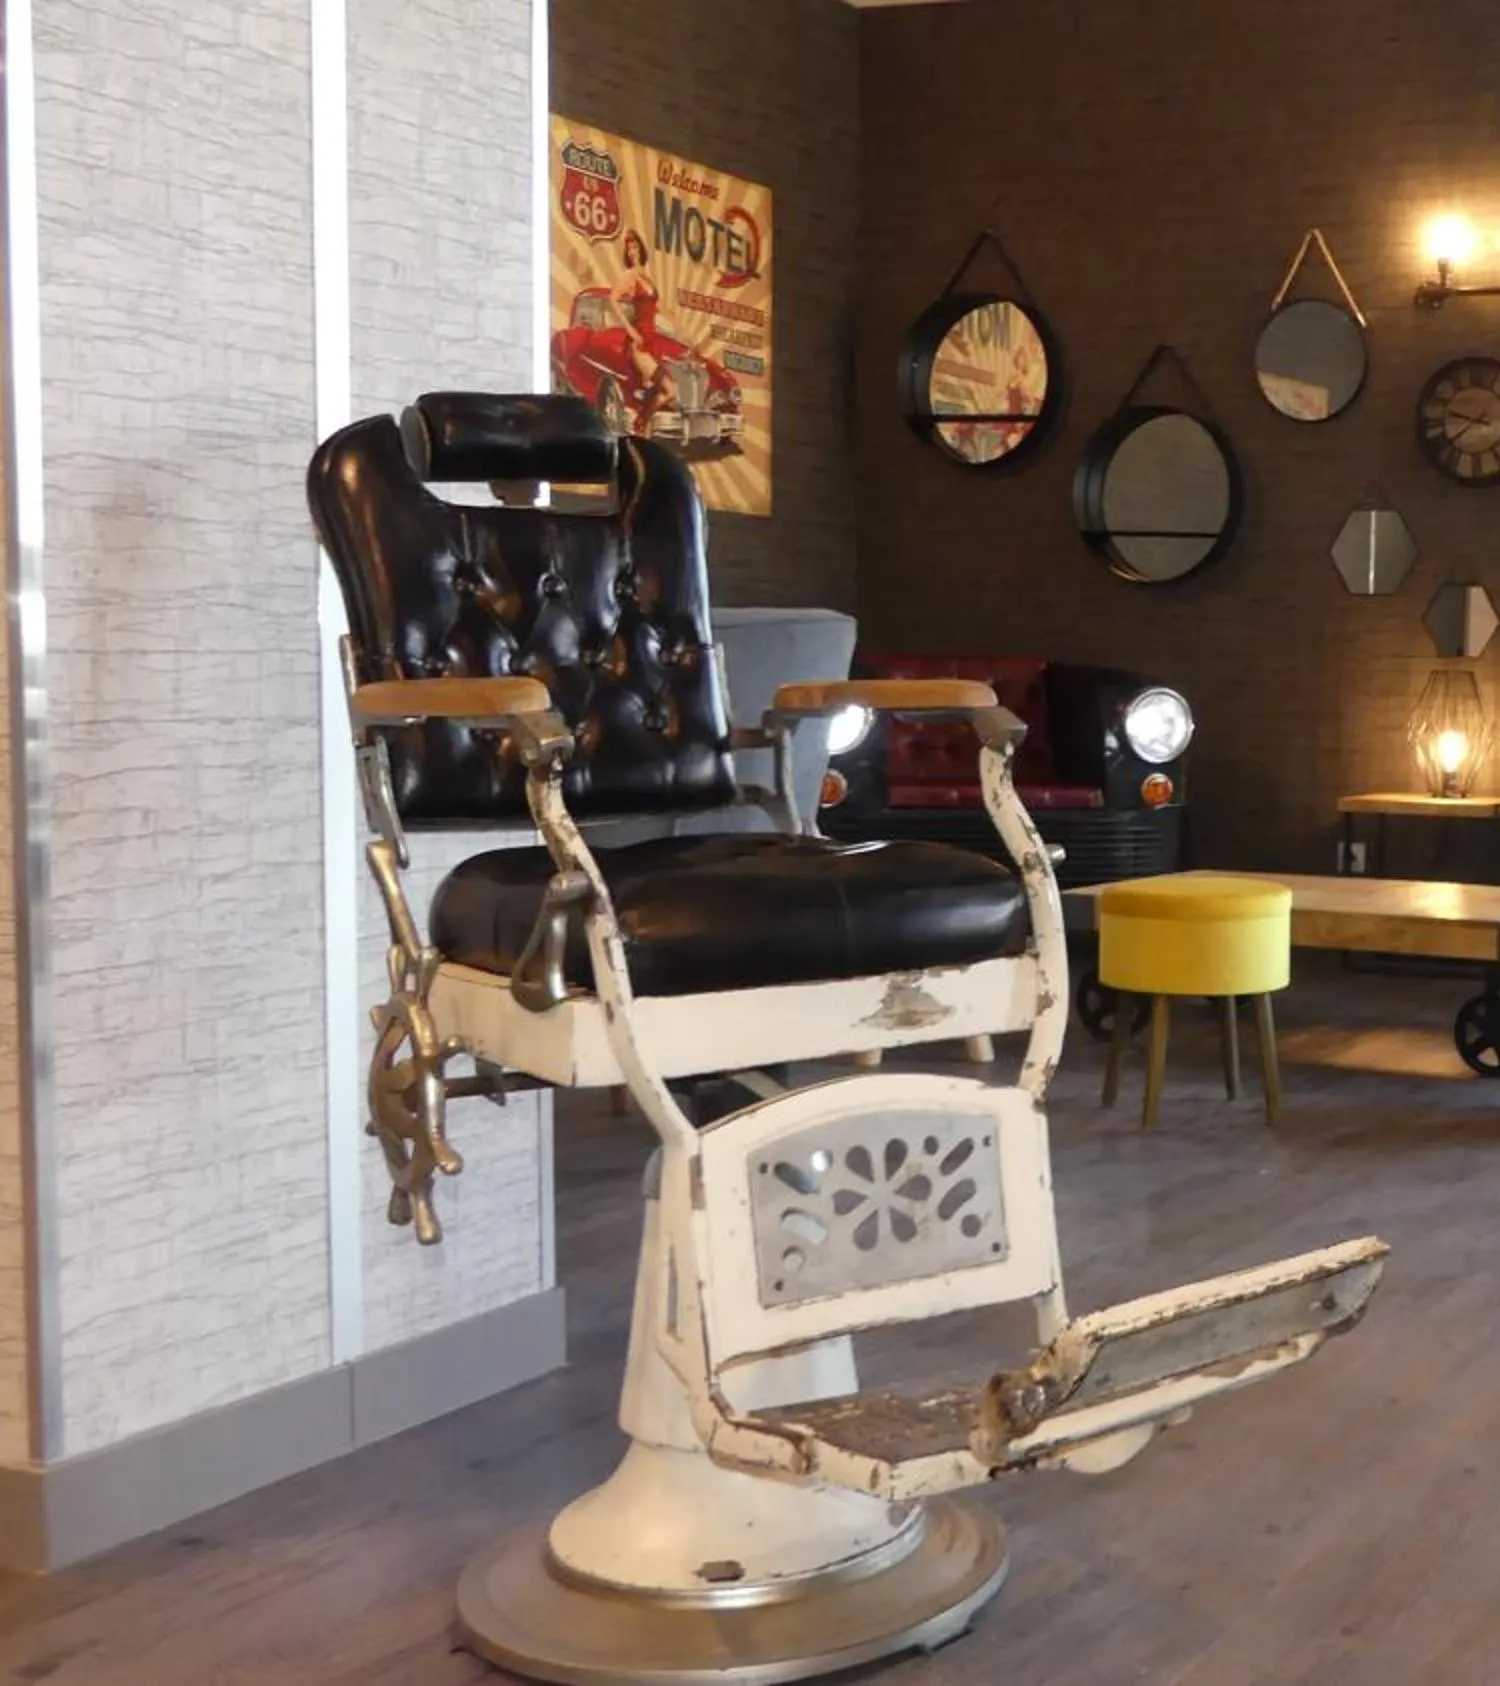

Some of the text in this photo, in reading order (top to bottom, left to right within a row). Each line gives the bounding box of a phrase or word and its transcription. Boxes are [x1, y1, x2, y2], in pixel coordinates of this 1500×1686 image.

[568, 147, 614, 178] ROUTE
[574, 191, 607, 231] 66
[654, 186, 761, 280] MOTEL
